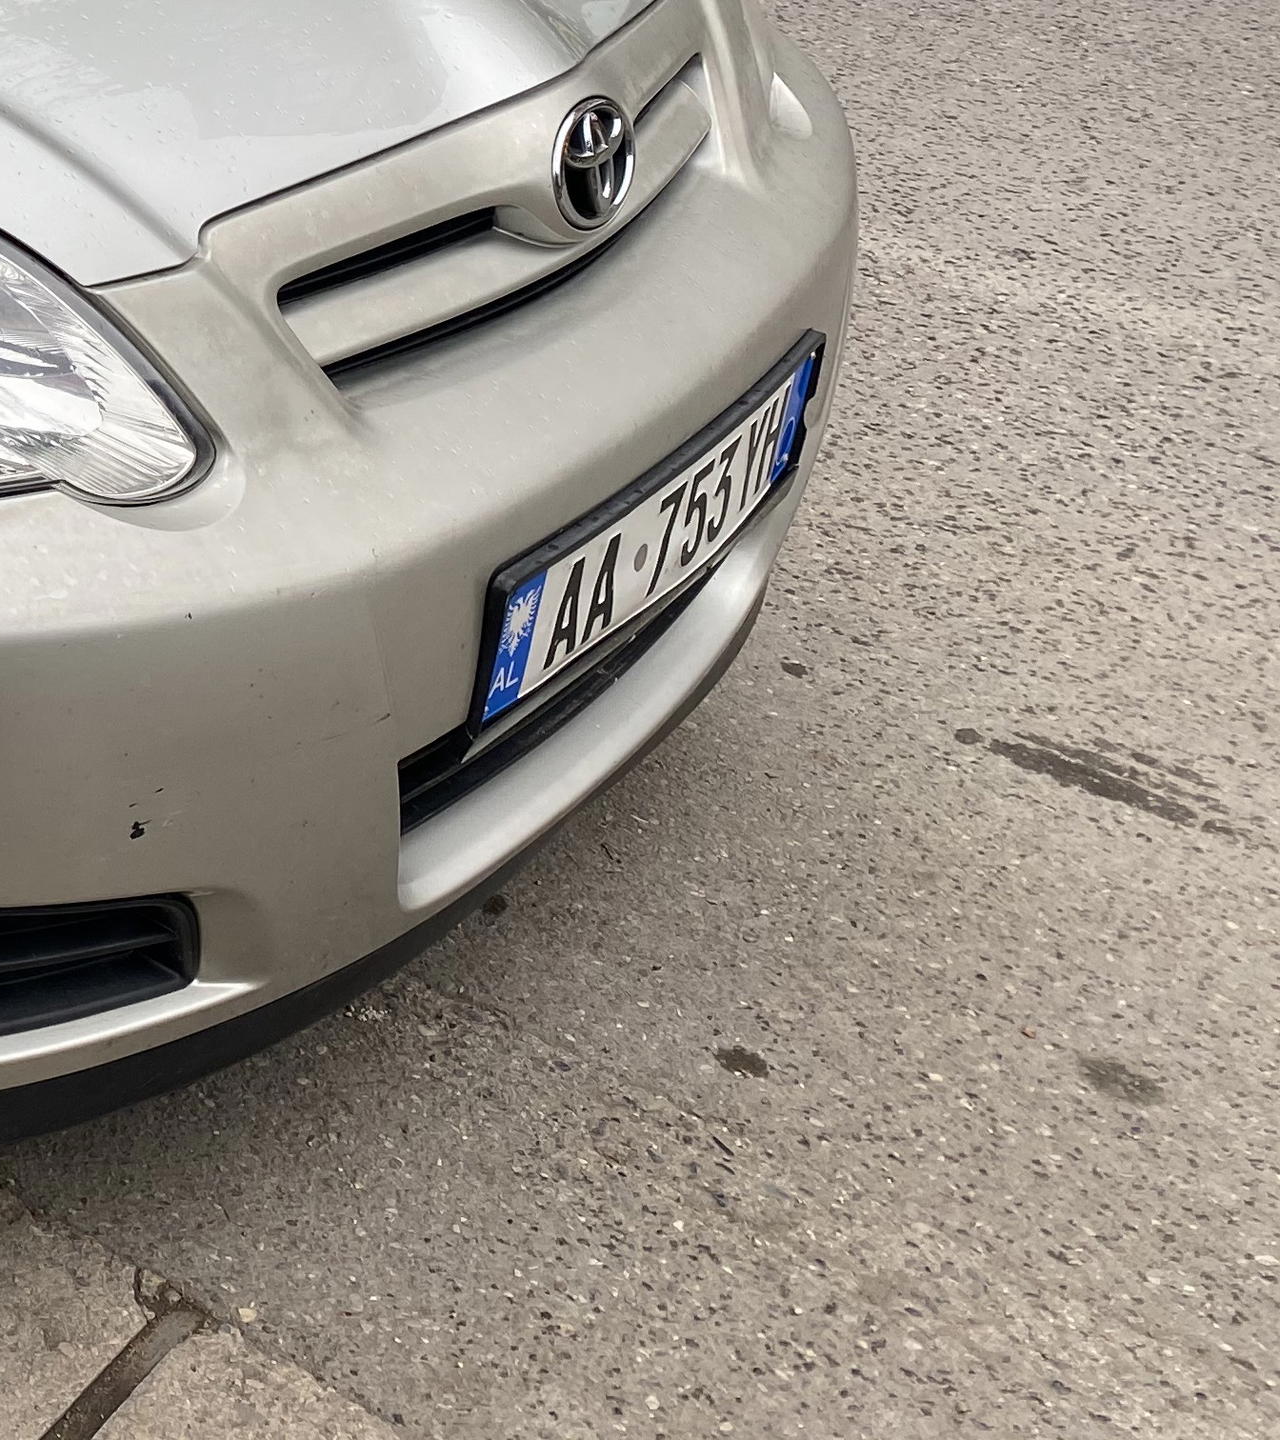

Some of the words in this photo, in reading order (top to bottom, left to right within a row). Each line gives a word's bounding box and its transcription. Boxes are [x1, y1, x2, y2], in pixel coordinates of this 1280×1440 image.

[543, 533, 622, 670] AA
[646, 434, 742, 598] 753
[739, 384, 792, 512] YH
[488, 666, 520, 698] AL
